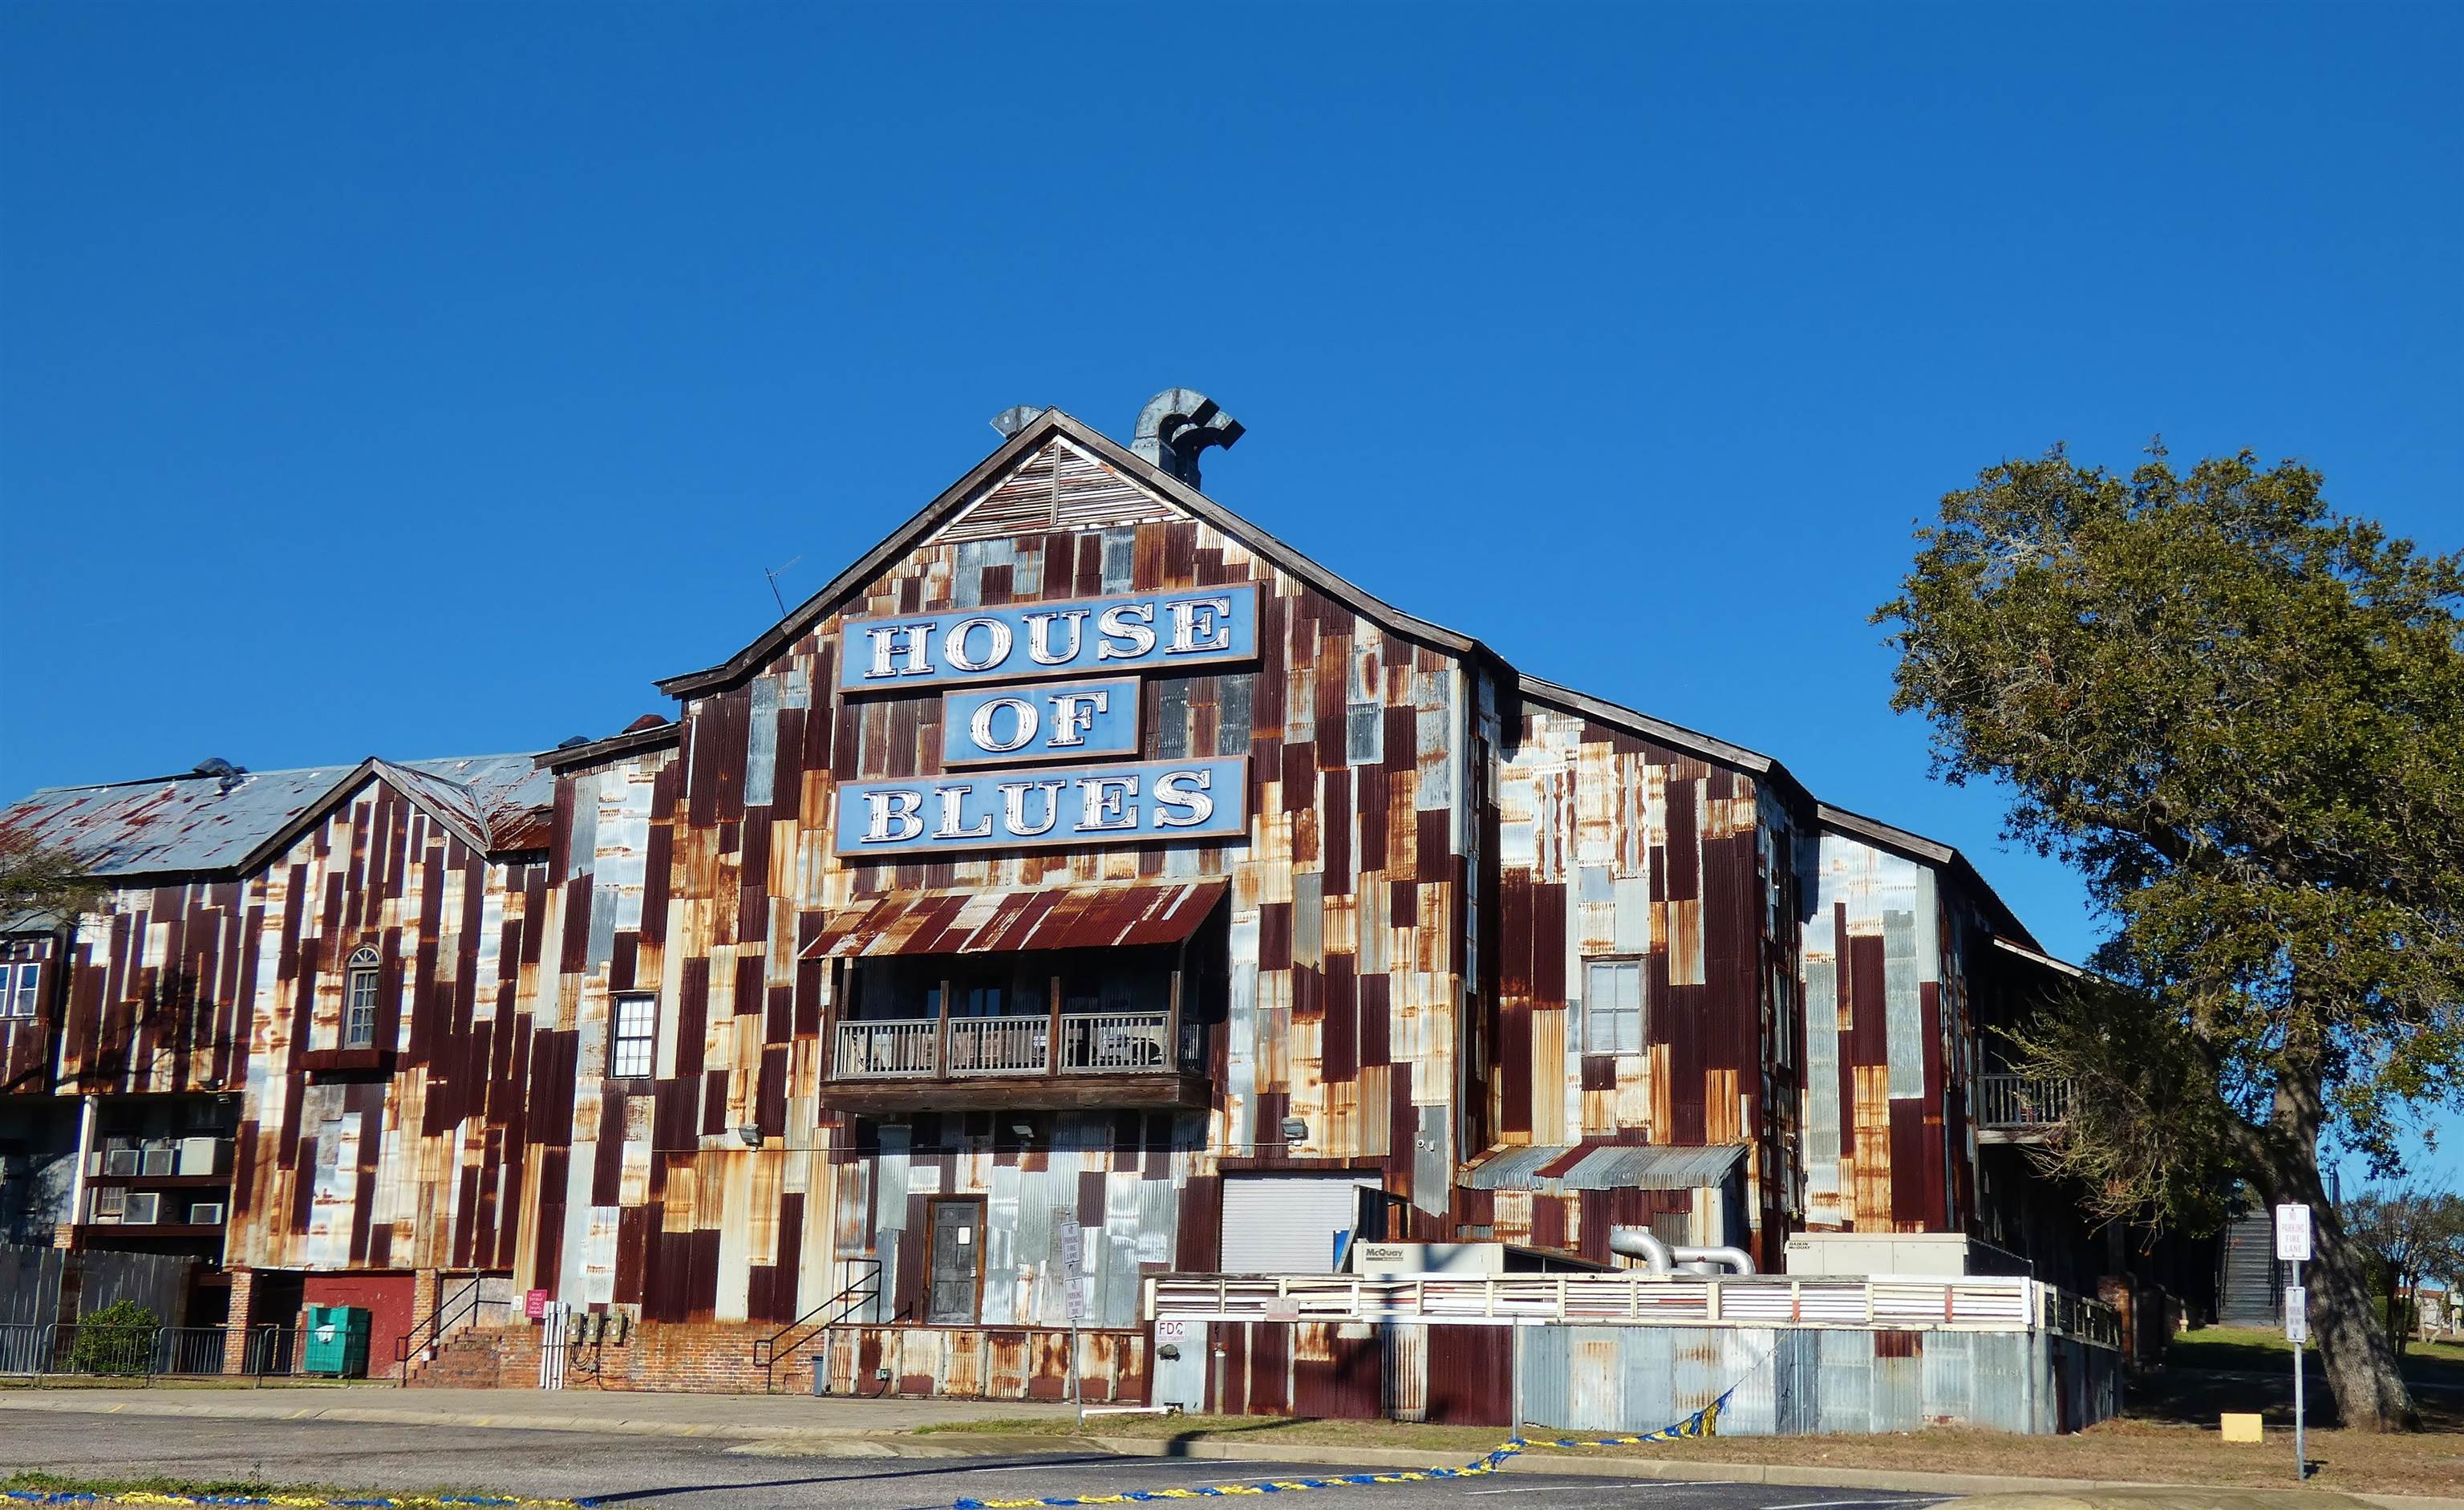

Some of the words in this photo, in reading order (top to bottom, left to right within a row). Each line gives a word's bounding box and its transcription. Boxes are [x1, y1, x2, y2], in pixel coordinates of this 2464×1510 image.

[864, 596, 1230, 679] HOUSE
[970, 691, 1108, 752] OF
[861, 769, 1214, 843] BLUES
[2281, 1224, 2304, 1232] PARKING
[2286, 1235, 2302, 1243] FIRE
[1366, 1248, 1404, 1256] McQuay
[2284, 1244, 2303, 1252] LANE
[1067, 1252, 1078, 1260] LANE
[1159, 1322, 1183, 1335] FDC
